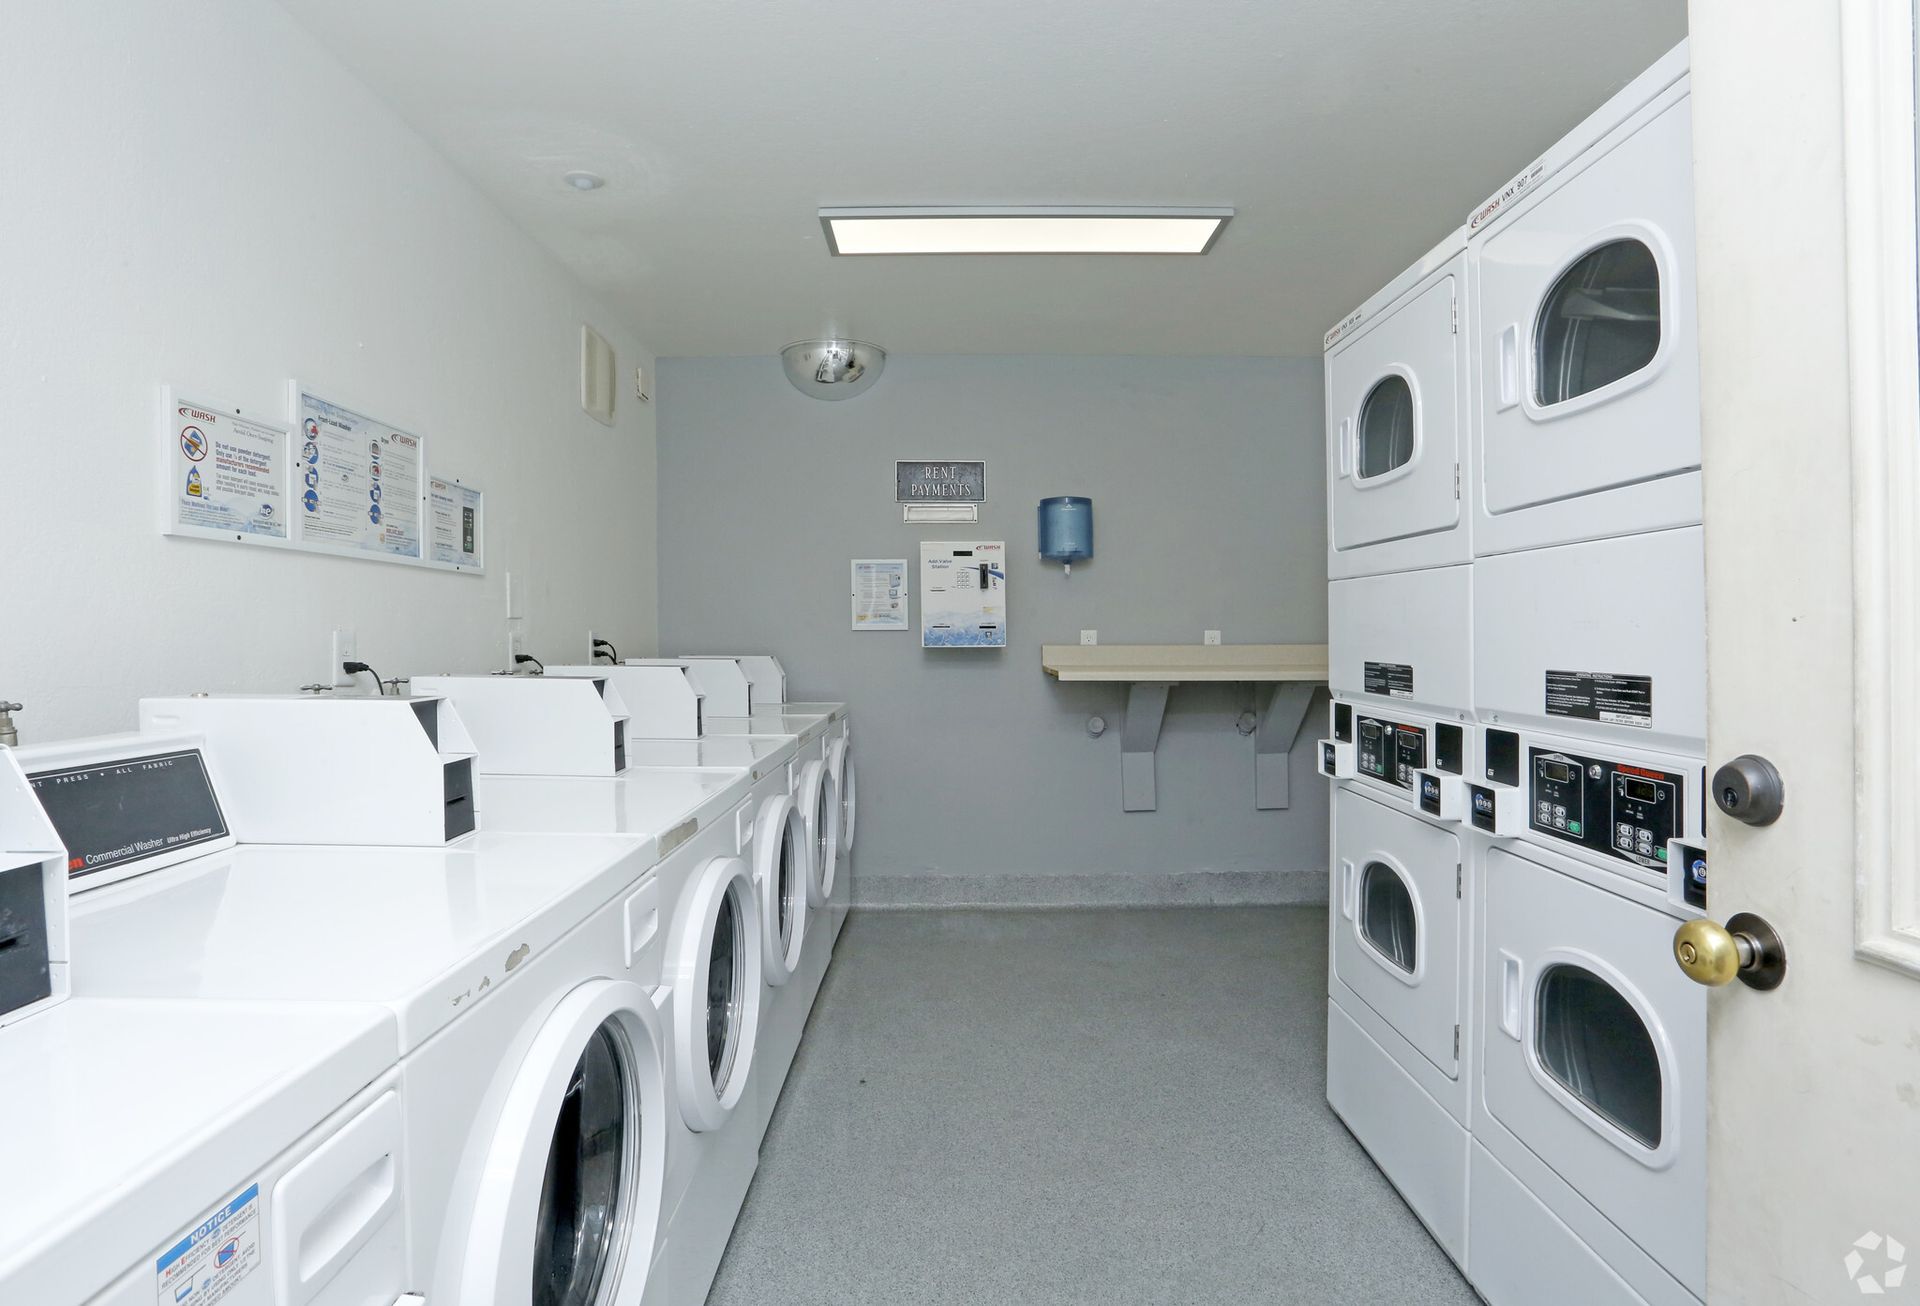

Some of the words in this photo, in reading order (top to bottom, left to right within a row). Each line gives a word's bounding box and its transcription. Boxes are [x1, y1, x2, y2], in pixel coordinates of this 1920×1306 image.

[191, 409, 216, 424] WASH
[400, 435, 417, 448] WASH
[925, 466, 956, 479] RENT
[911, 483, 971, 496] PAYMENTS
[116, 767, 133, 775] ALL
[142, 760, 174, 770] FABRIC
[56, 774, 89, 784] PRESS
[86, 843, 136, 865] Commercial
[134, 837, 163, 852] Washer
[166, 836, 179, 844] Ultra
[179, 833, 190, 841] High
[190, 827, 212, 838] Efficiency
[1635, 856, 1651, 864] LOWER
[190, 1205, 232, 1245] NOTICE
